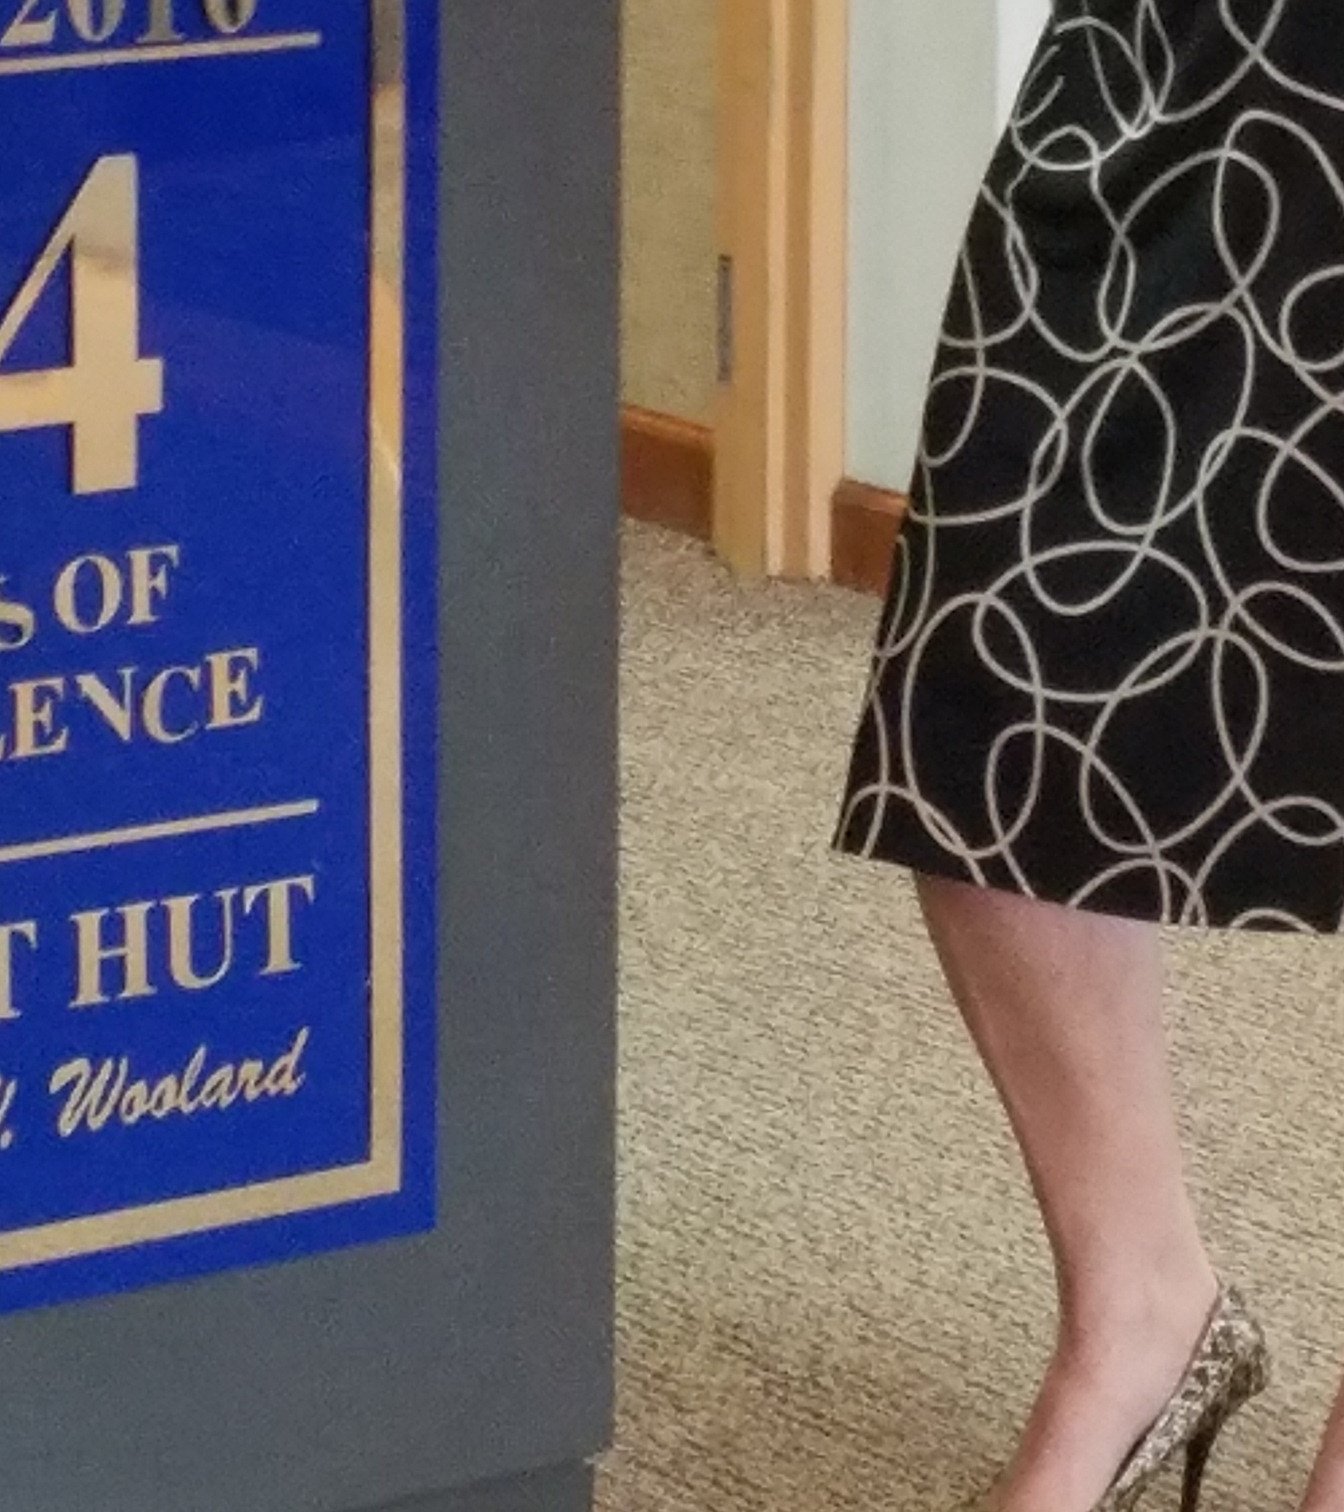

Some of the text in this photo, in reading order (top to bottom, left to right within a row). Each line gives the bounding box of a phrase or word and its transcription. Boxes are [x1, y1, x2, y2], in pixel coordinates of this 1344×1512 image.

[54, 544, 180, 634] OF
[69, 874, 314, 1008] HUT
[48, 1026, 310, 1137] Woolard
